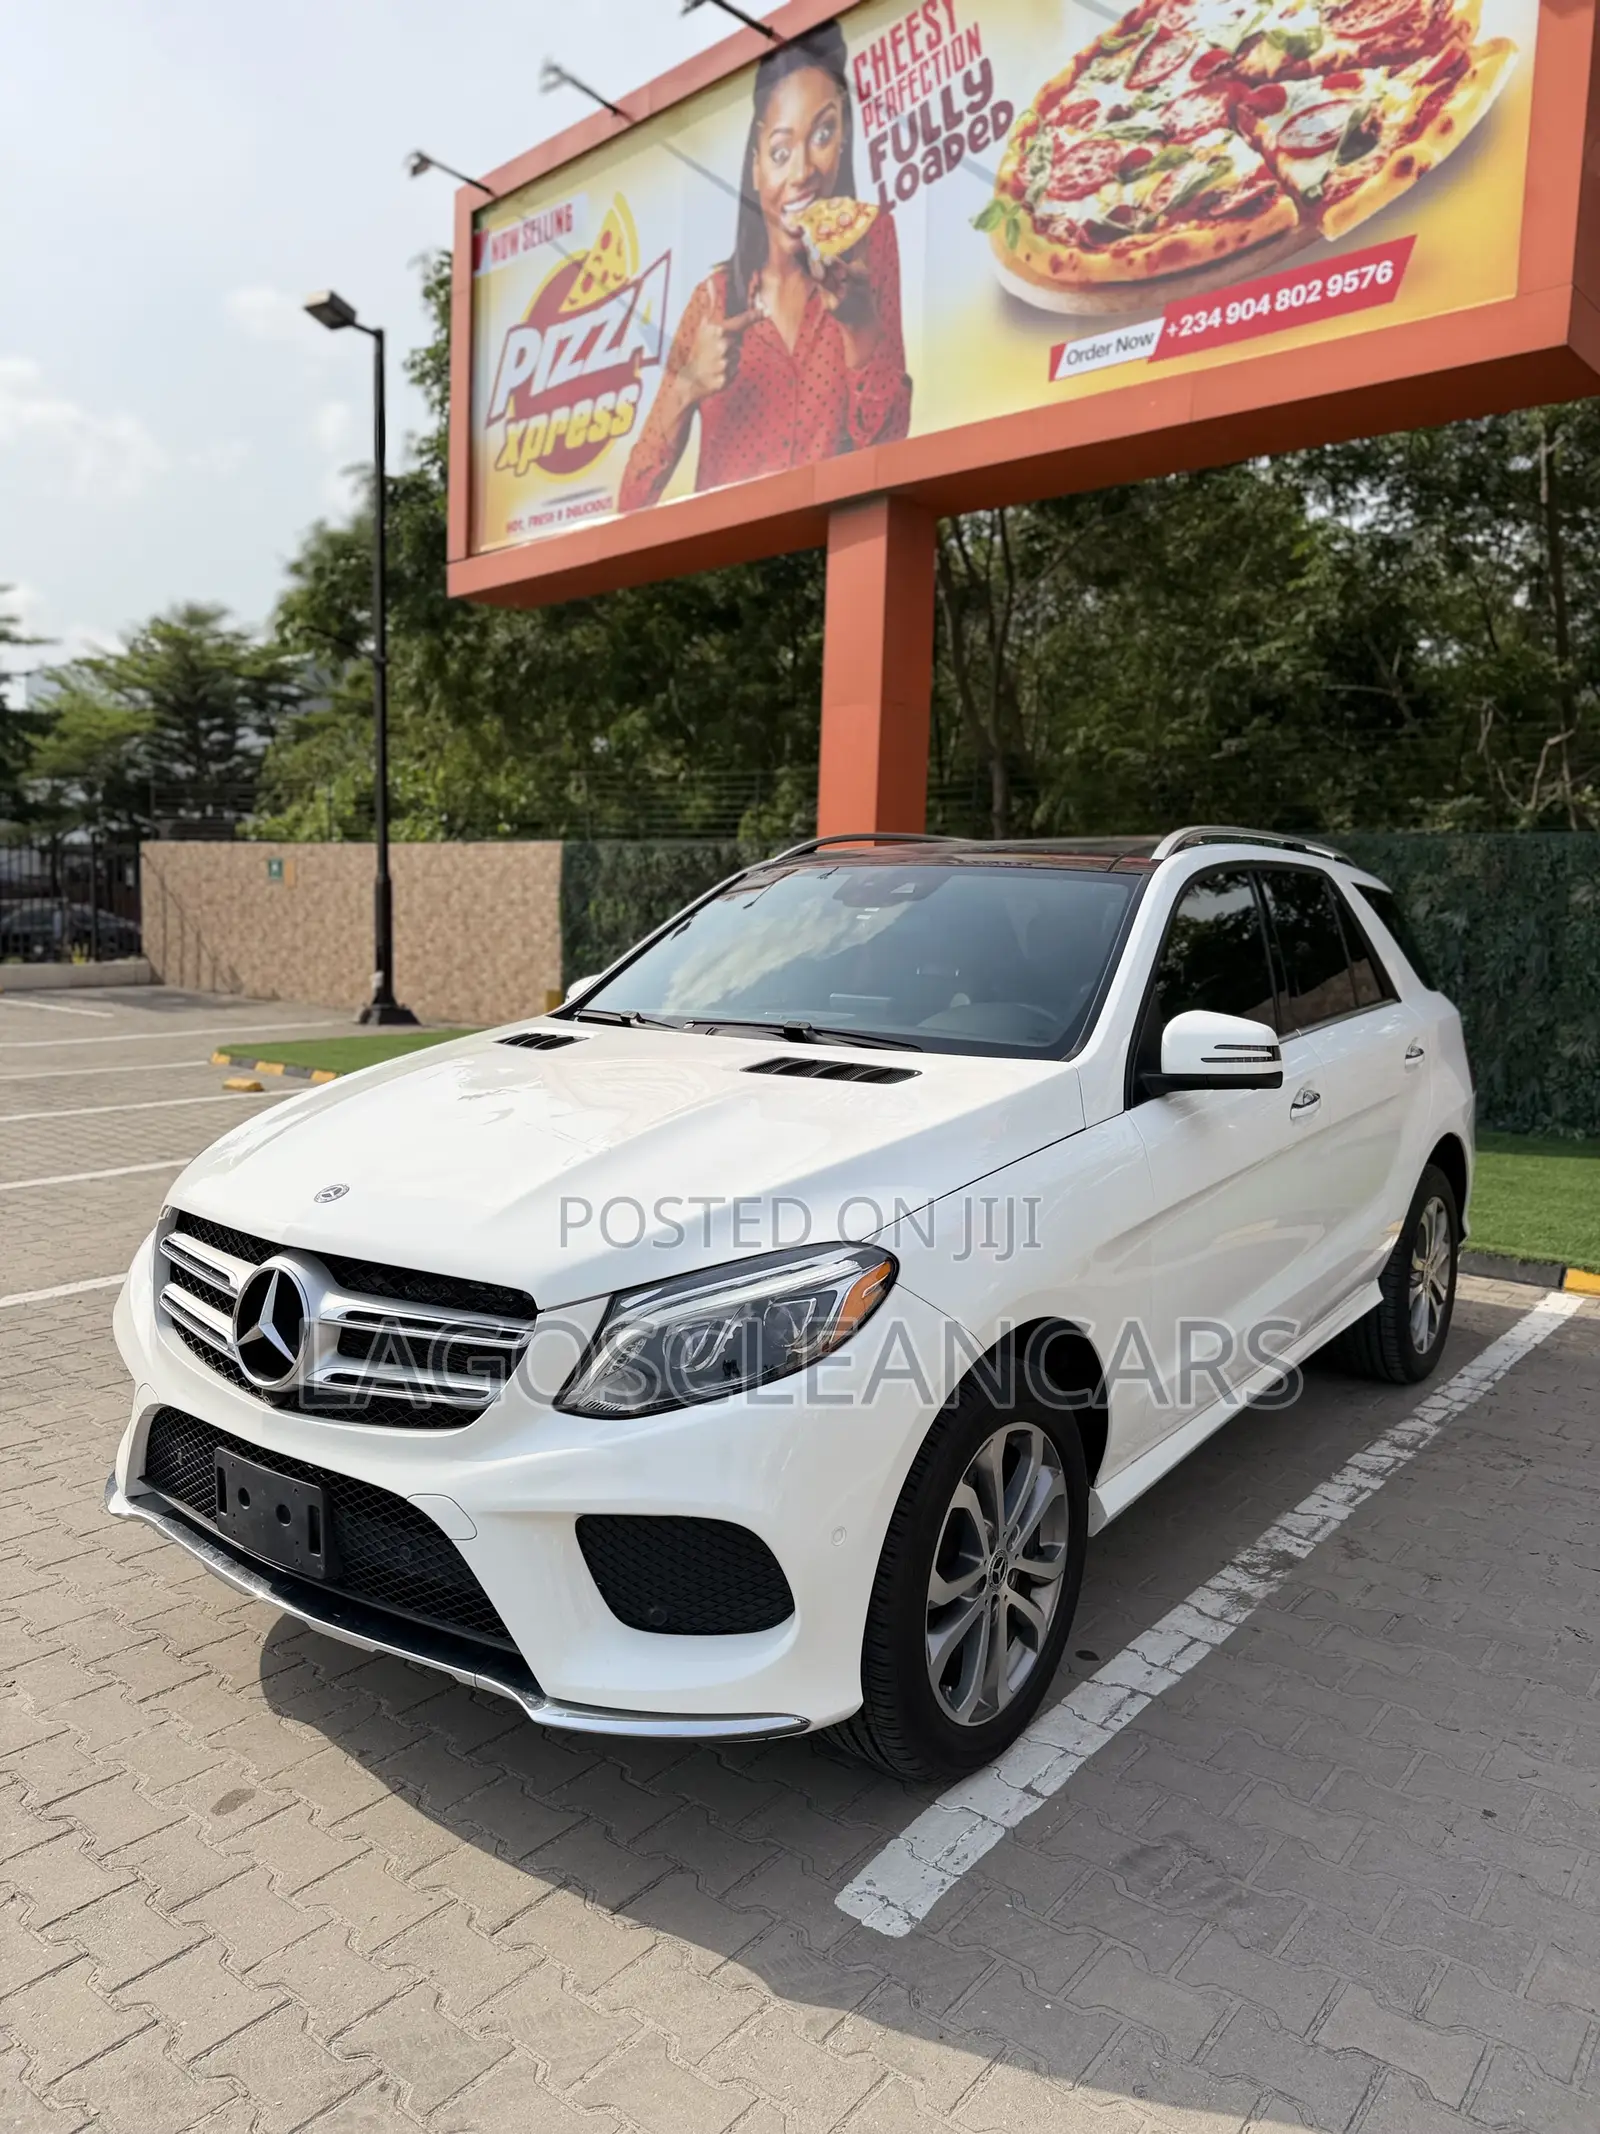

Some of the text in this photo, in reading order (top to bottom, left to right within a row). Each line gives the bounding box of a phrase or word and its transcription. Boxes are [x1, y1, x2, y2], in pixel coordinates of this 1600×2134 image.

[853, 0, 956, 104] CHEESY
[861, 22, 982, 138] PERFECTION
[523, 203, 572, 252] SELLING
[486, 249, 671, 429] PIZZA
[1166, 260, 1393, 339] +234 904 802 9576
[1066, 331, 1155, 366] Order Now
